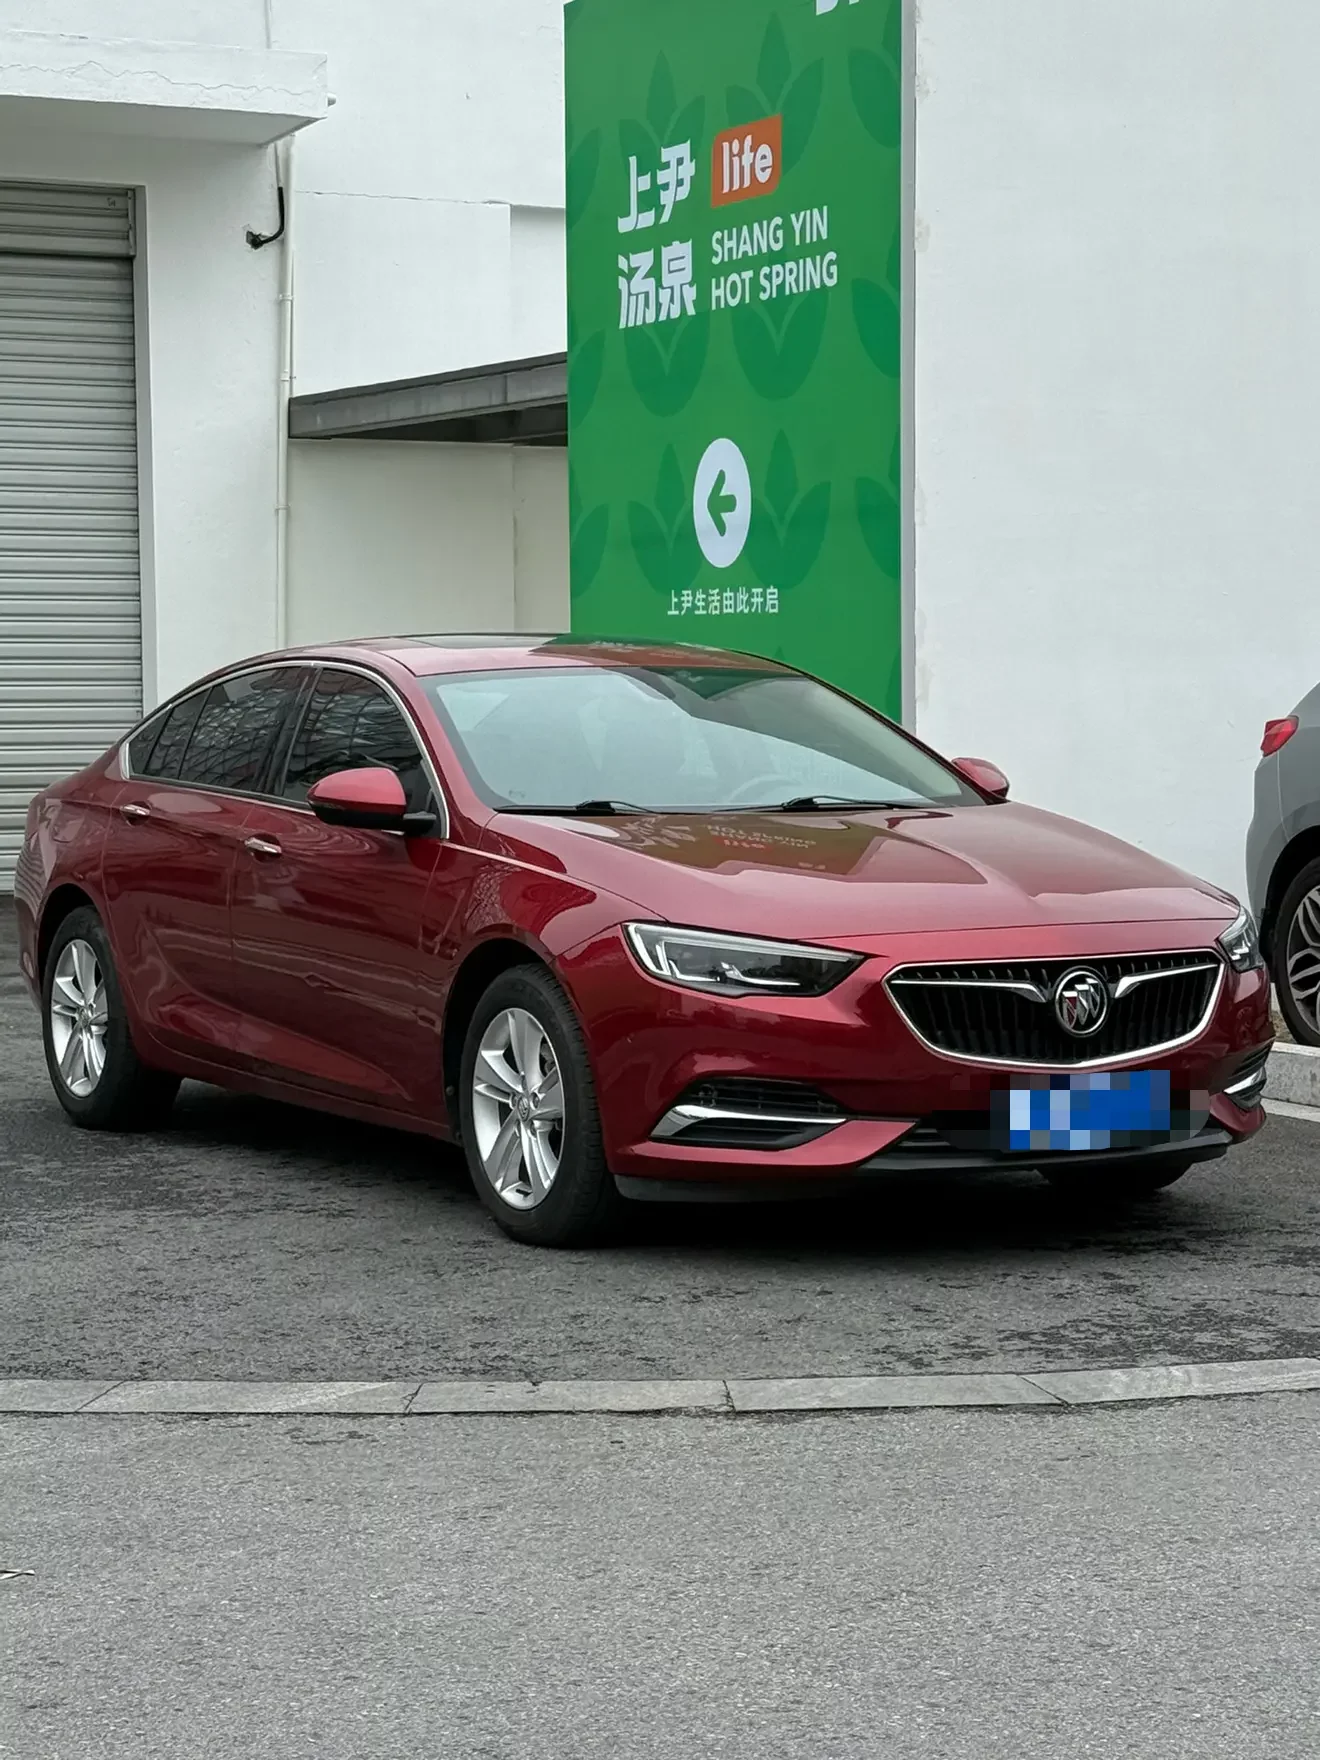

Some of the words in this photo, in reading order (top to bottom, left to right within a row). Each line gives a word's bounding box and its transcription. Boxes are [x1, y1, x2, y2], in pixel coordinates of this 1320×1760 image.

[617, 139, 696, 233] 上尹
[721, 134, 773, 194] life
[711, 216, 783, 265] SHANG
[790, 205, 828, 246] YIN
[617, 238, 697, 329] 汤泉
[711, 270, 754, 310] HOT
[758, 251, 838, 300] SPRING
[667, 585, 779, 616] 上尹生活由此开启
